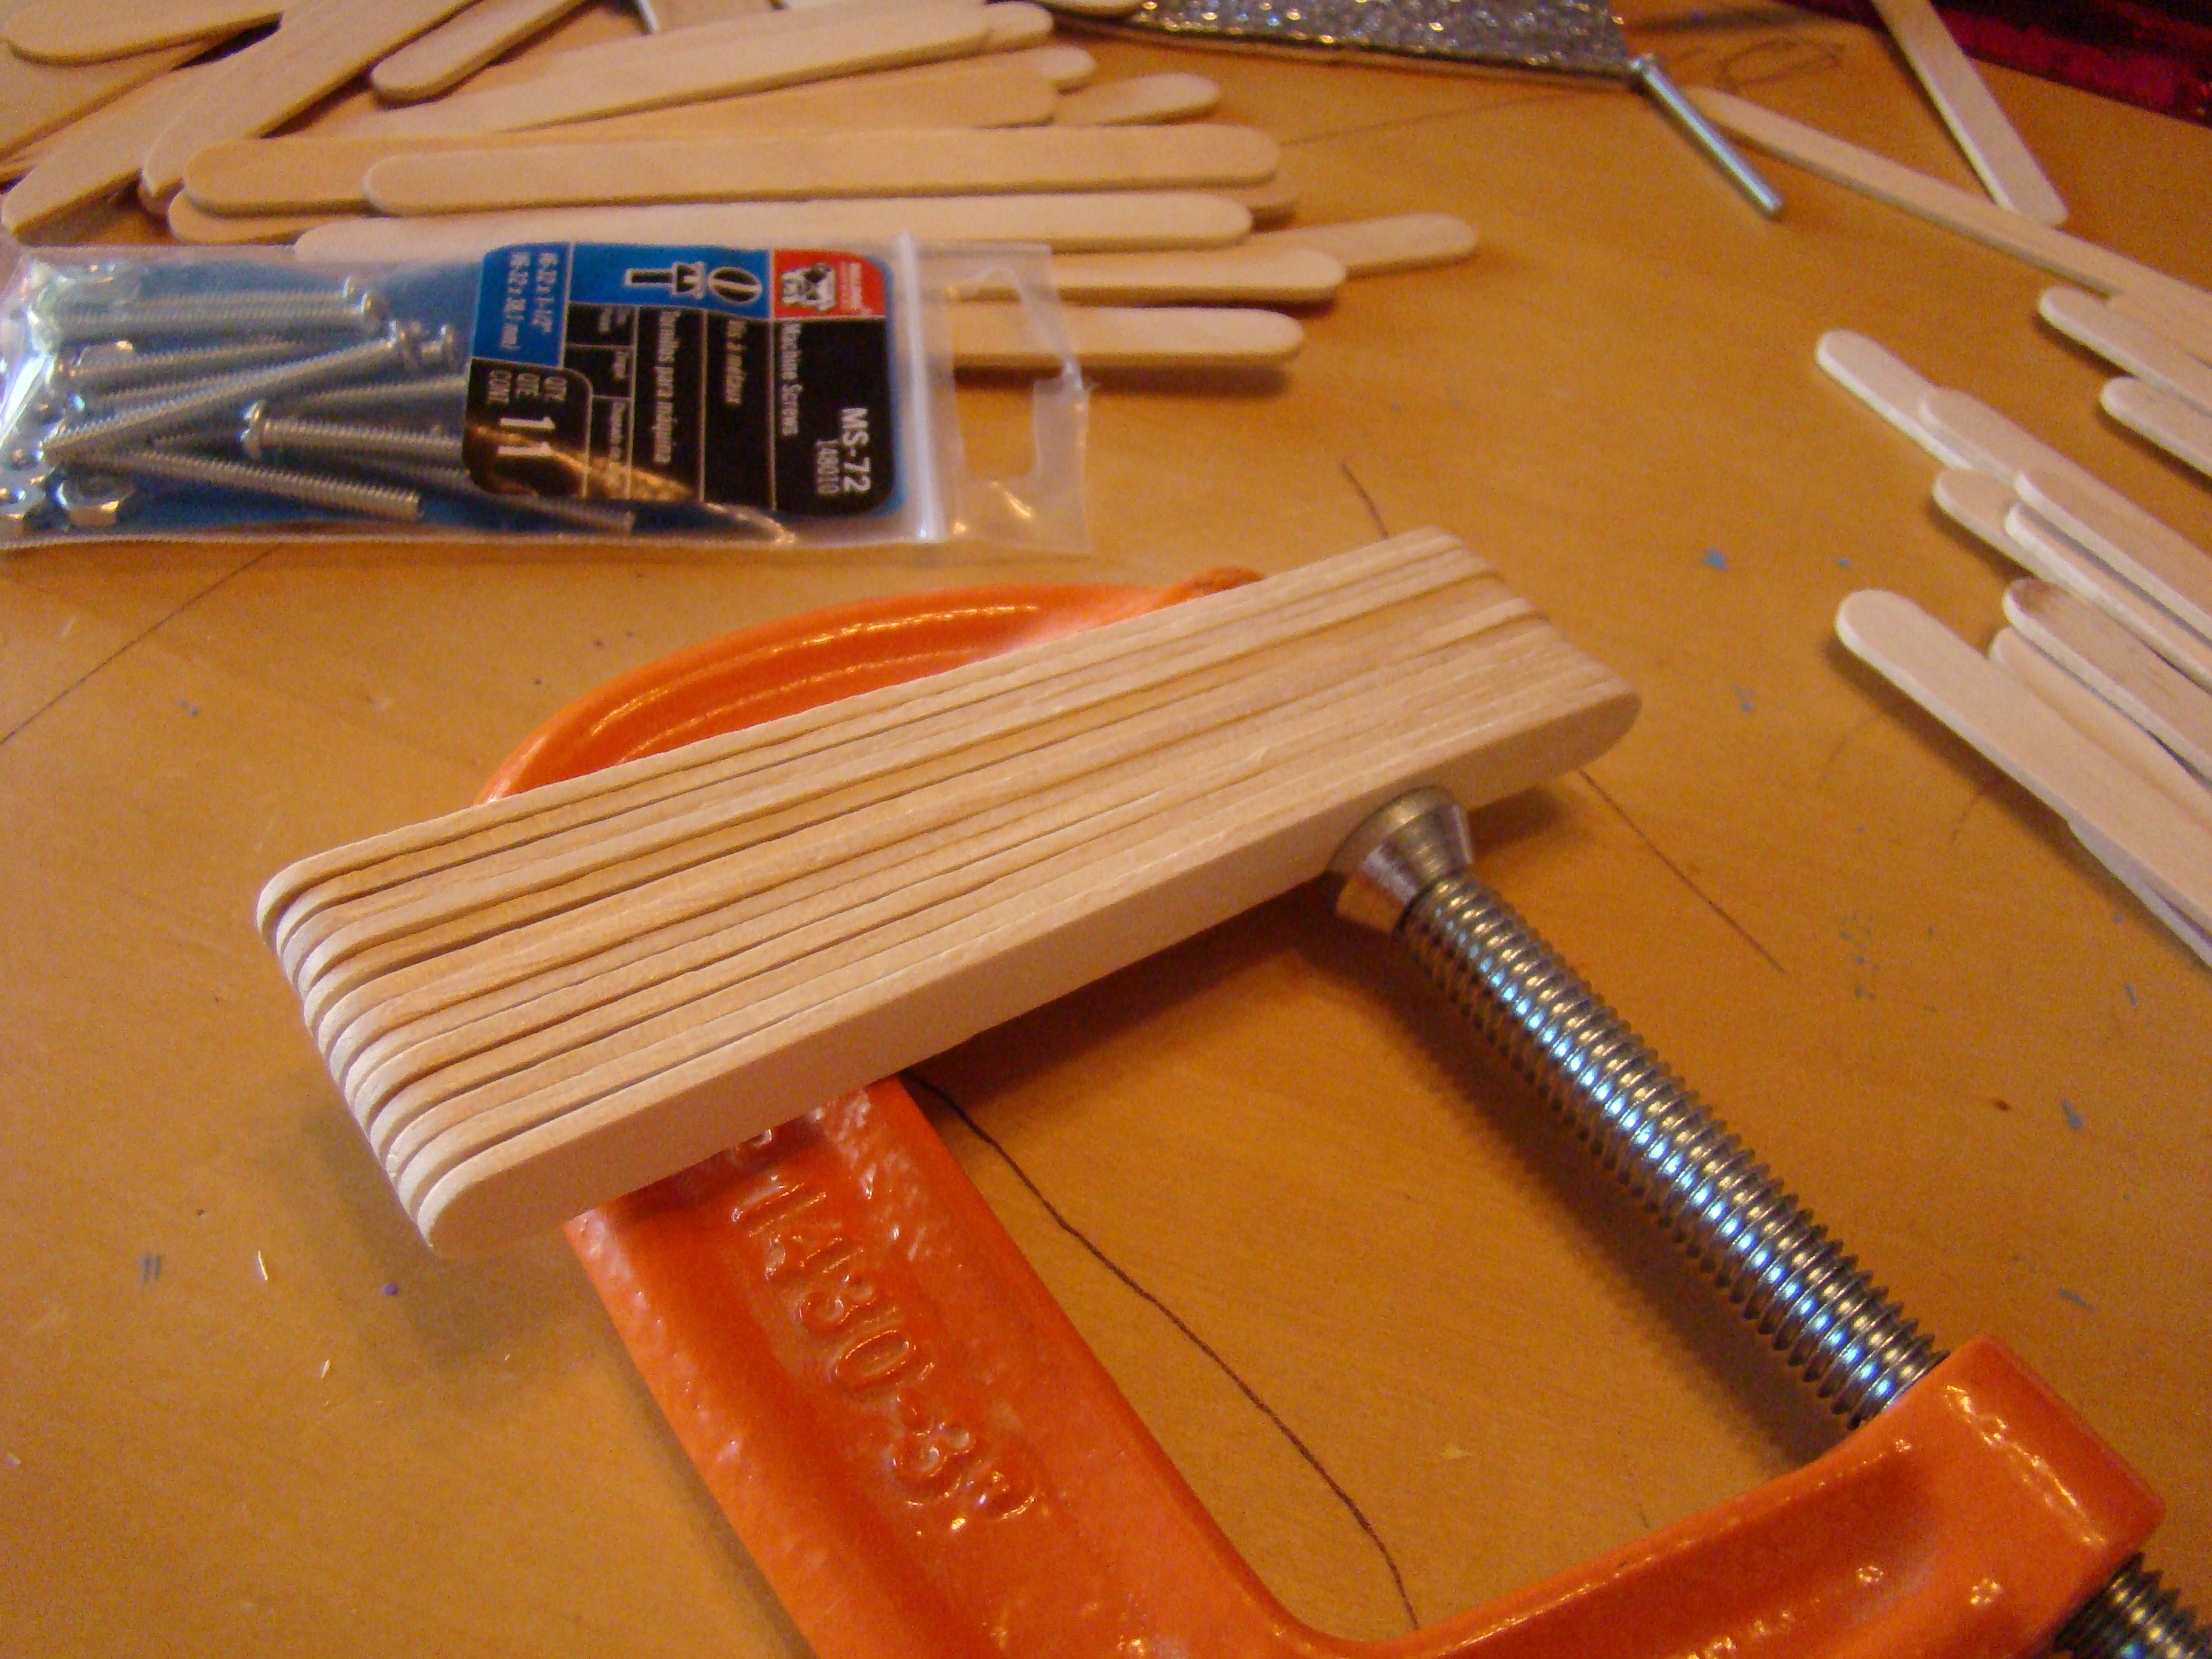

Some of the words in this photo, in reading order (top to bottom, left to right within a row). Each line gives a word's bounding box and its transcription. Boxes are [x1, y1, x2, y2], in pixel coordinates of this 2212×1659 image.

[780, 323, 802, 382] Machine
[655, 366, 674, 398] para
[497, 416, 556, 457] 11
[781, 383, 803, 437] Screws
[841, 407, 872, 493] MS-72
